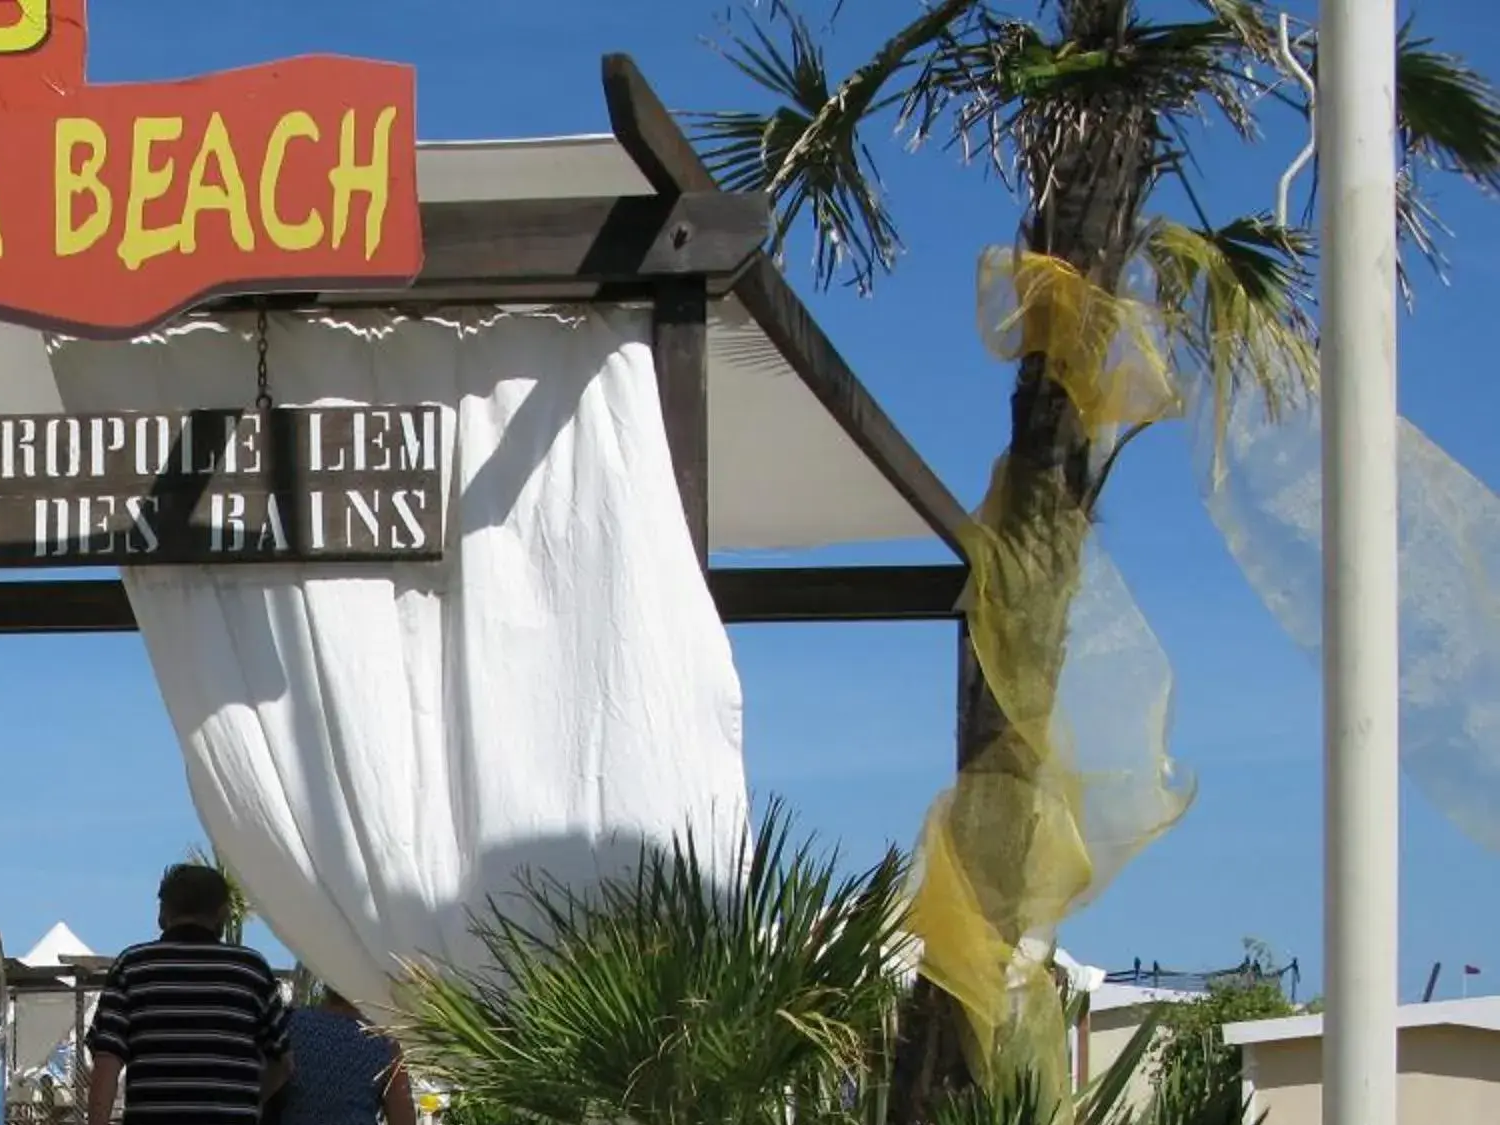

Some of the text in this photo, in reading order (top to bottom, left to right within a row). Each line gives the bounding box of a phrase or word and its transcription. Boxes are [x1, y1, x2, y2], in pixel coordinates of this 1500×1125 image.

[54, 106, 396, 270] BEACH
[308, 411, 436, 472] LEM
[35, 494, 159, 557] DES
[210, 489, 426, 551] BAINS
